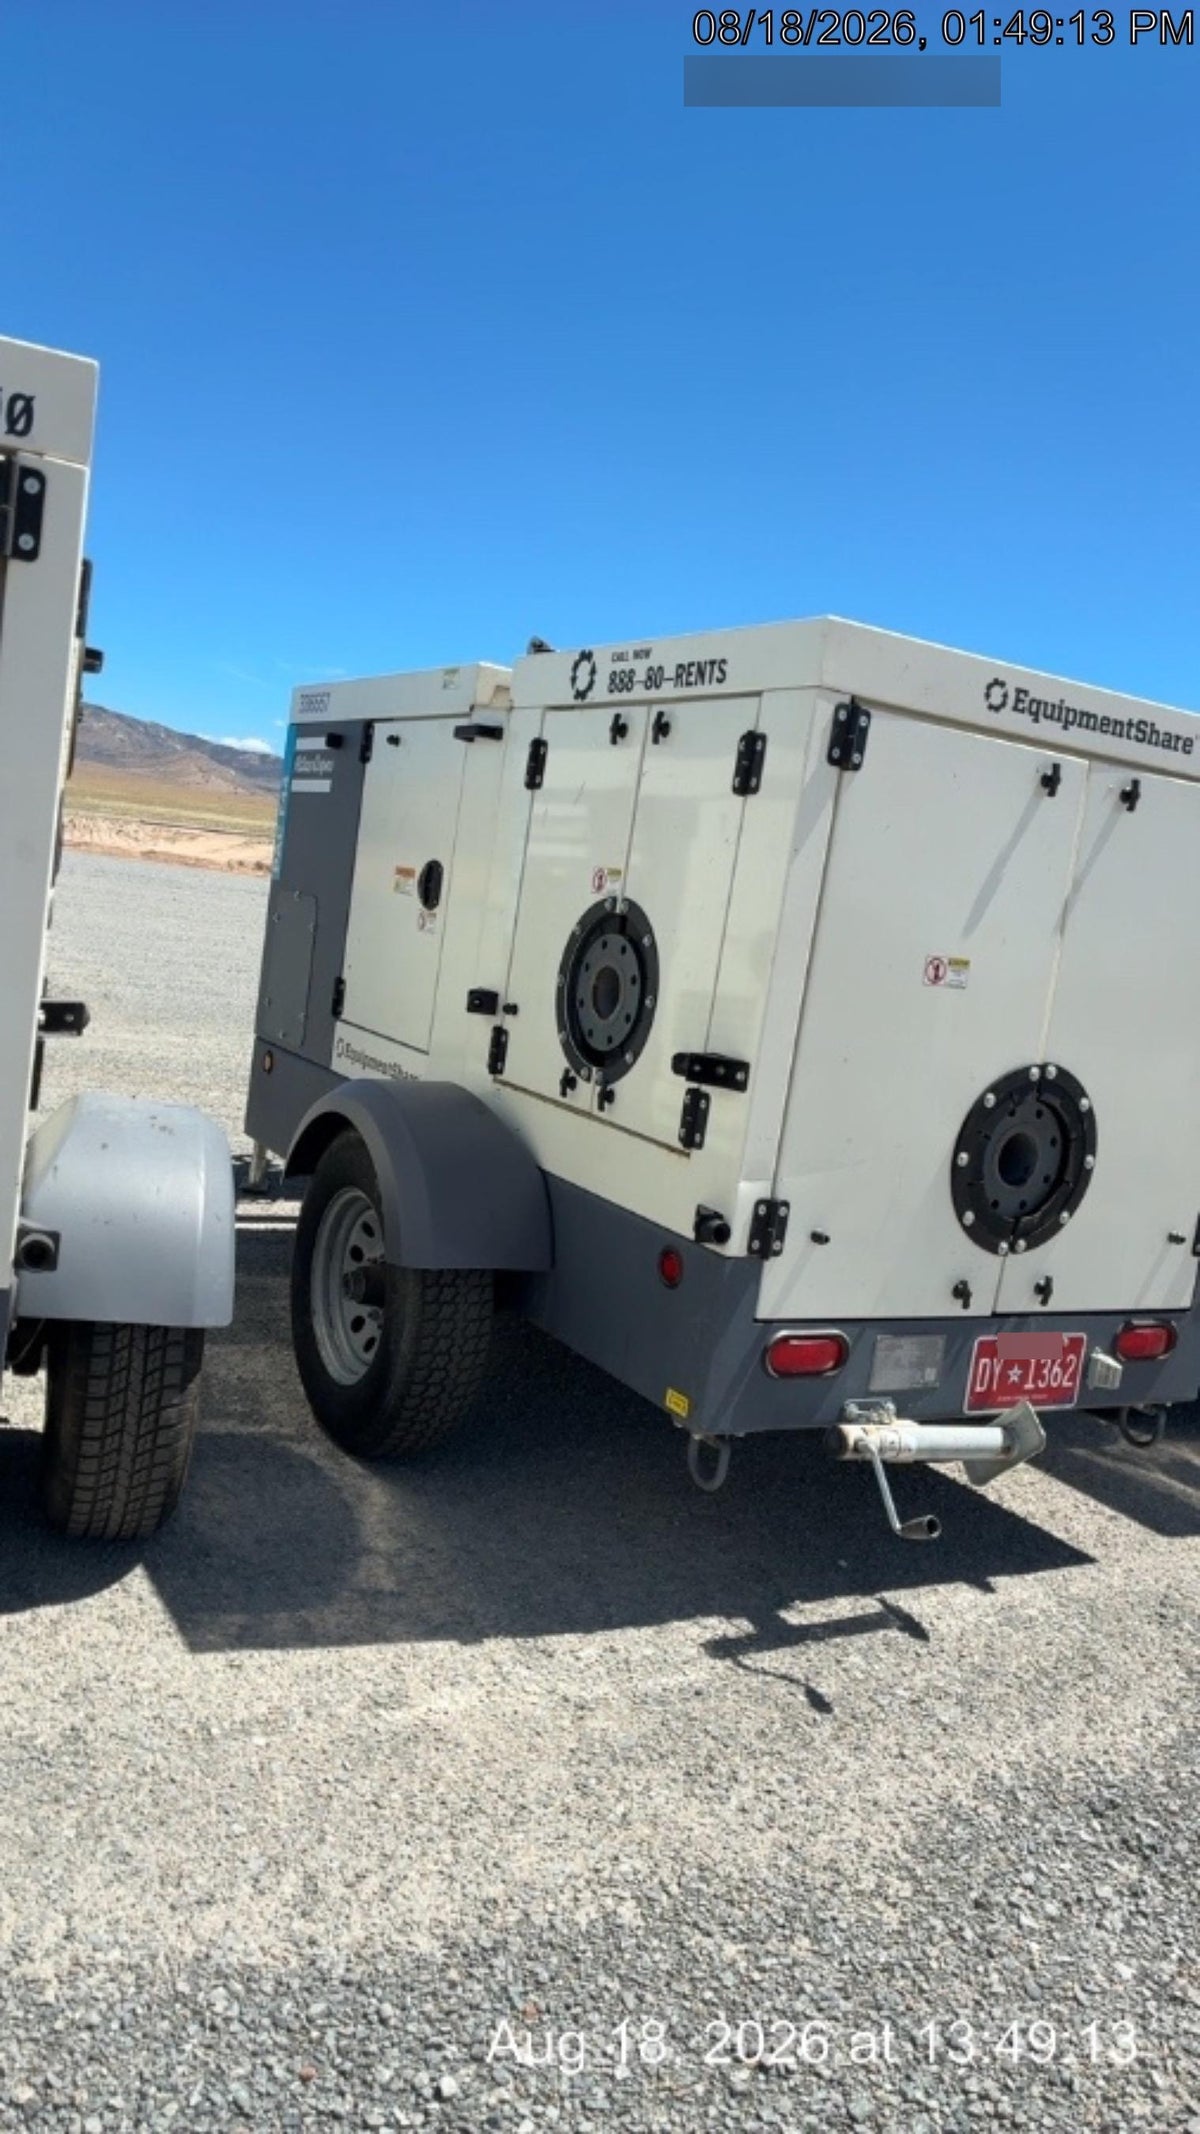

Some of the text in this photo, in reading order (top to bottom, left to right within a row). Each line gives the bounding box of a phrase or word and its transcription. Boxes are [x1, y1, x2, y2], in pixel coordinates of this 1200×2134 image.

[633, 647, 652, 660] NOW
[607, 659, 728, 694] 888-80-RENTS
[1011, 686, 1194, 755] EquipmentShare
